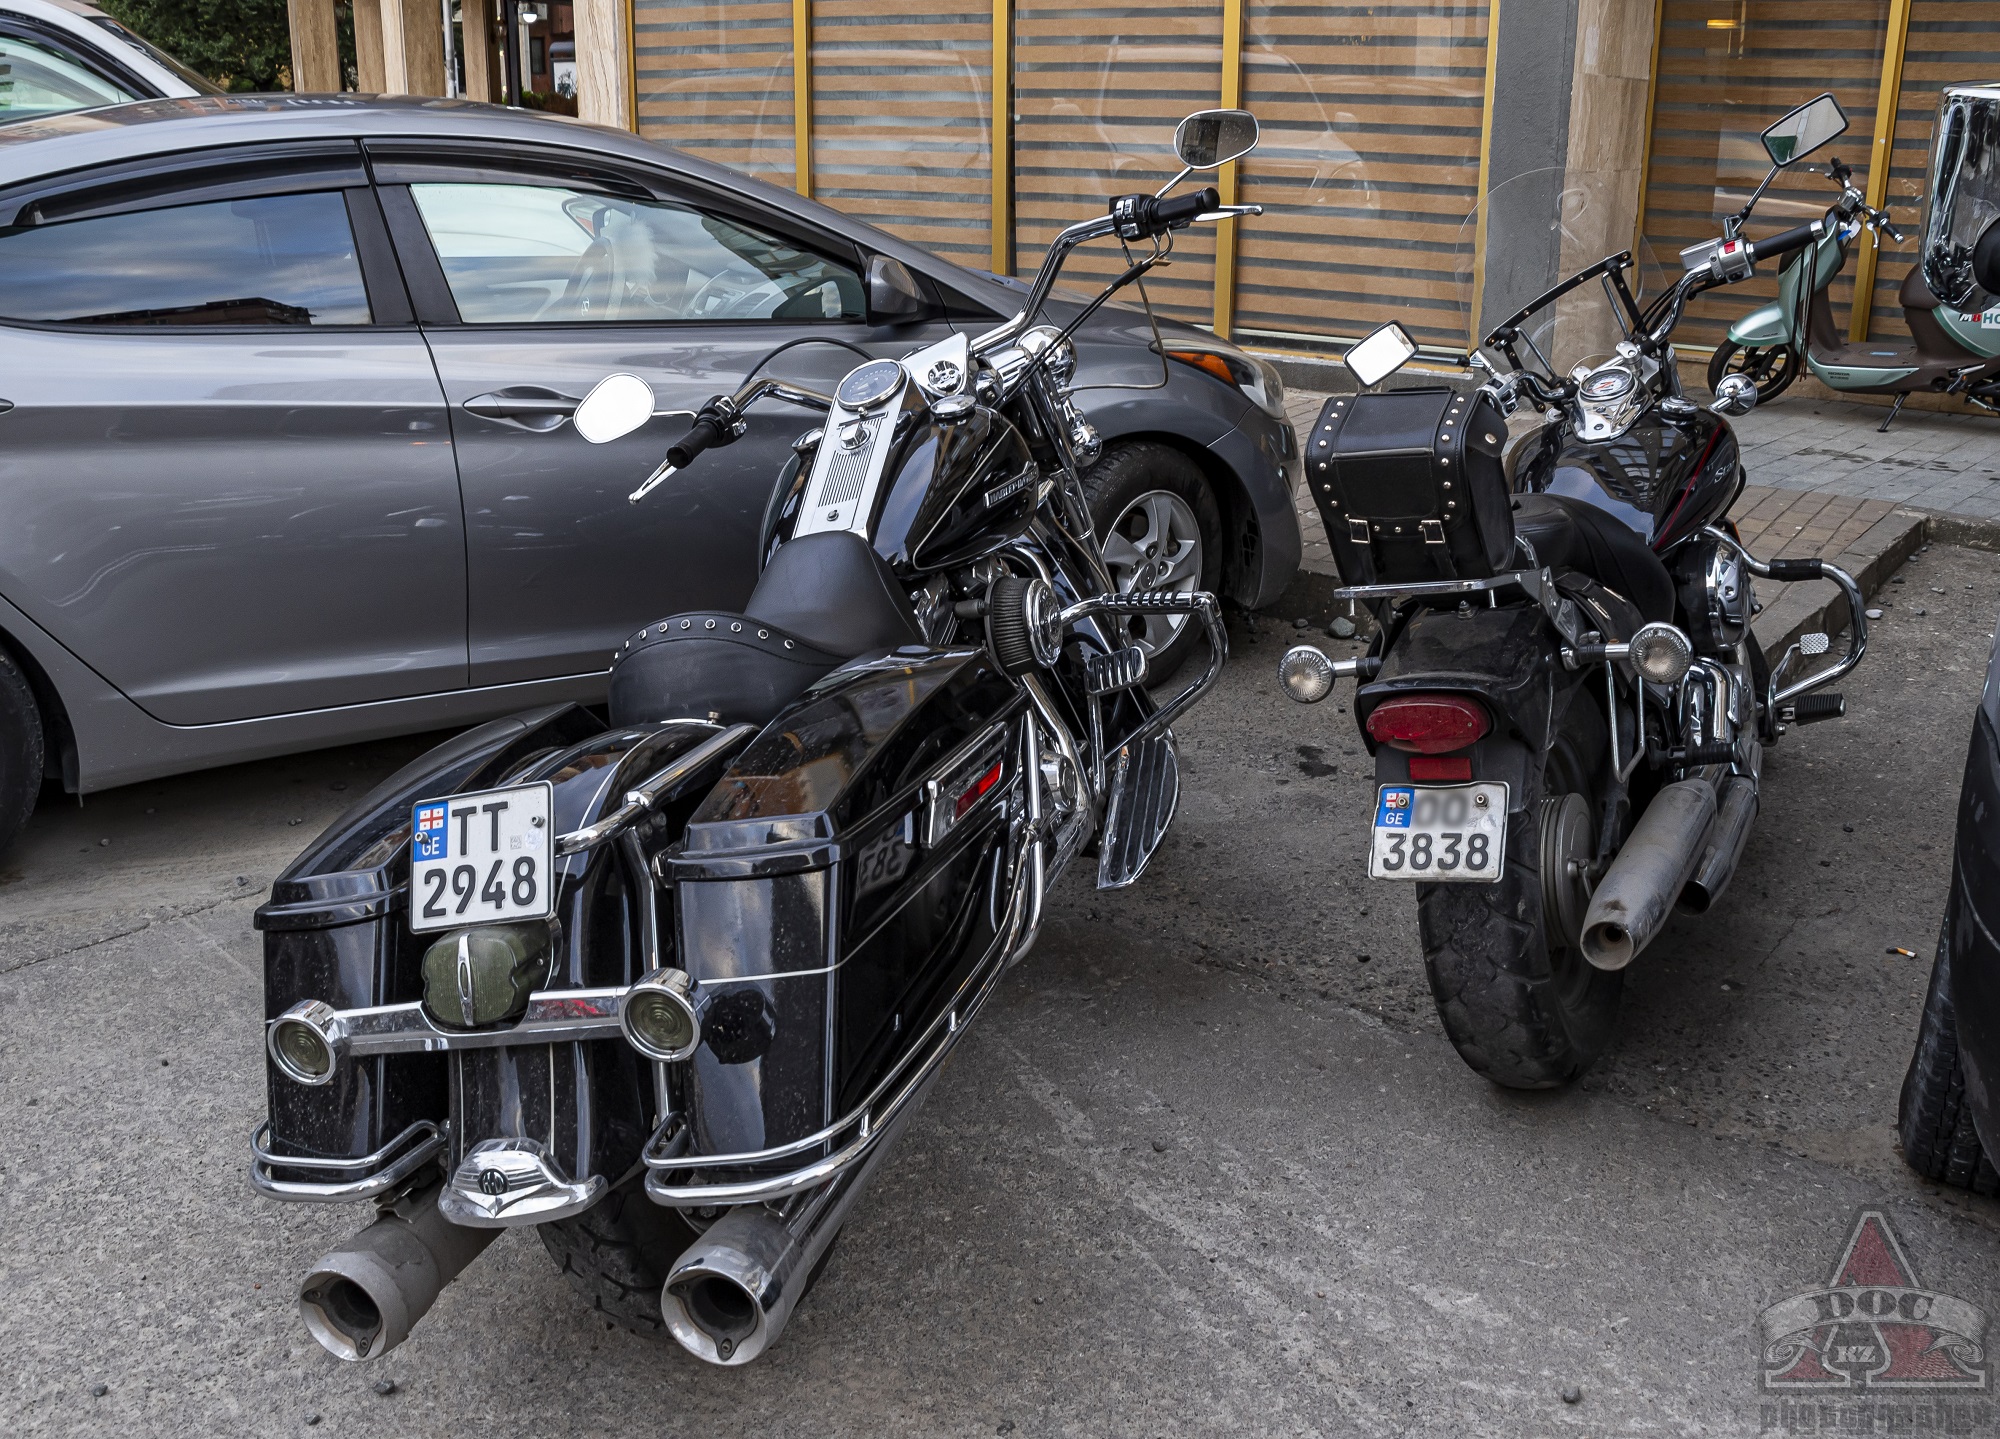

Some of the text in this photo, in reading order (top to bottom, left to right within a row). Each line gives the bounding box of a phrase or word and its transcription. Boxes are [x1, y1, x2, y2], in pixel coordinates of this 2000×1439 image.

[451, 801, 509, 856] TT
[1385, 812, 1405, 825] GE
[421, 836, 440, 856] GE
[1382, 832, 1489, 871] 3838
[422, 856, 538, 919] 2948
